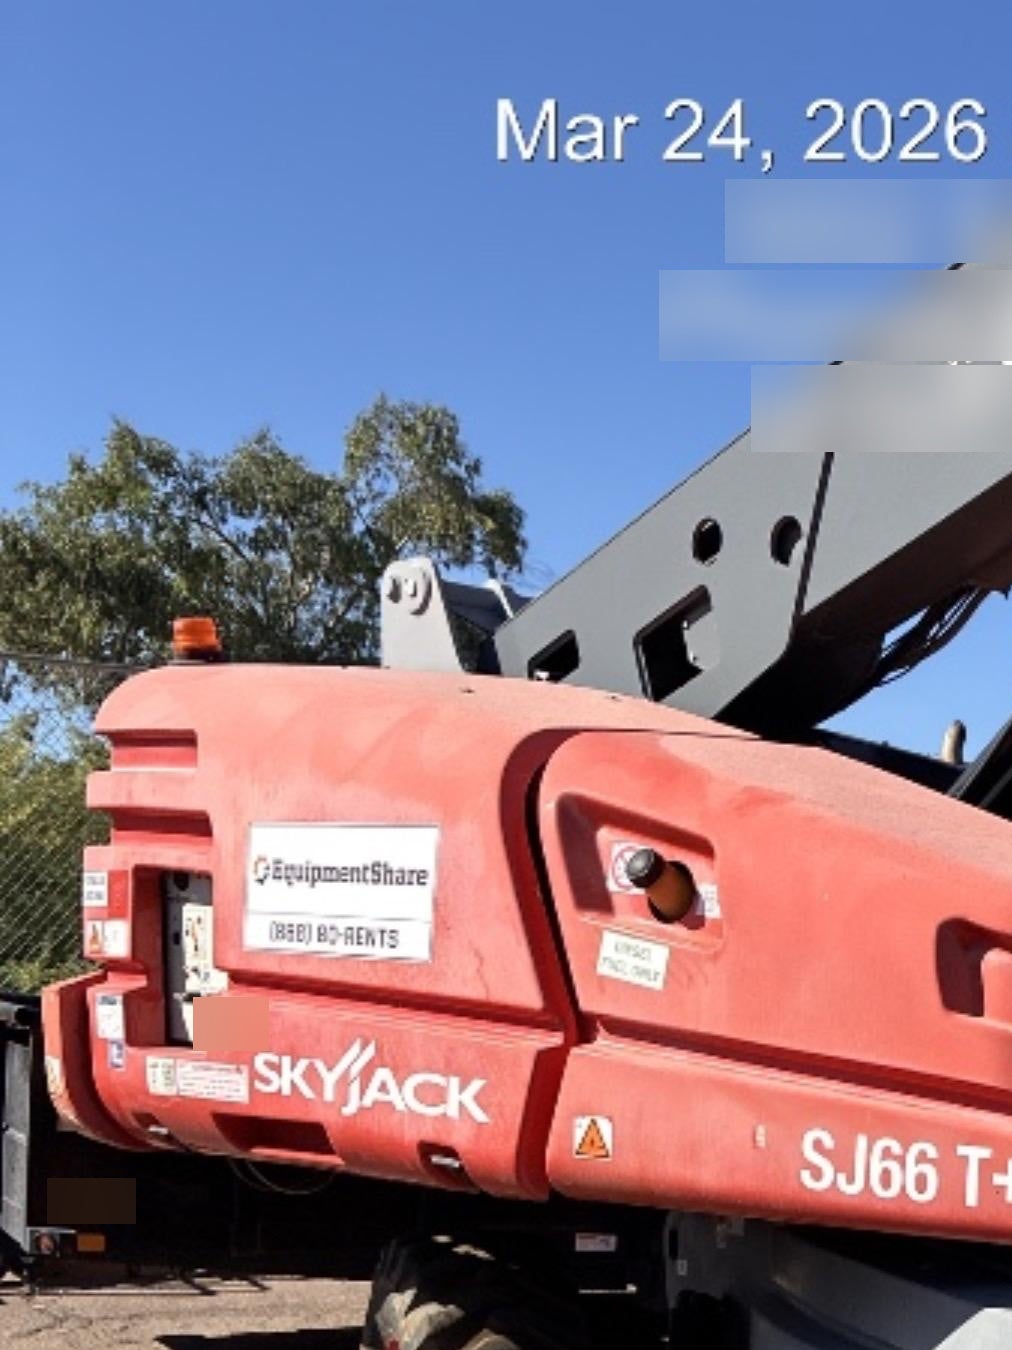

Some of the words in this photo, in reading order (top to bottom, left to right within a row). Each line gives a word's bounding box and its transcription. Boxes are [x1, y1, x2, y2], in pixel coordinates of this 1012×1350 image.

[271, 858, 430, 889] EquipmentShare
[253, 1038, 491, 1124] SKYJACK
[800, 1127, 940, 1204] SJ66
